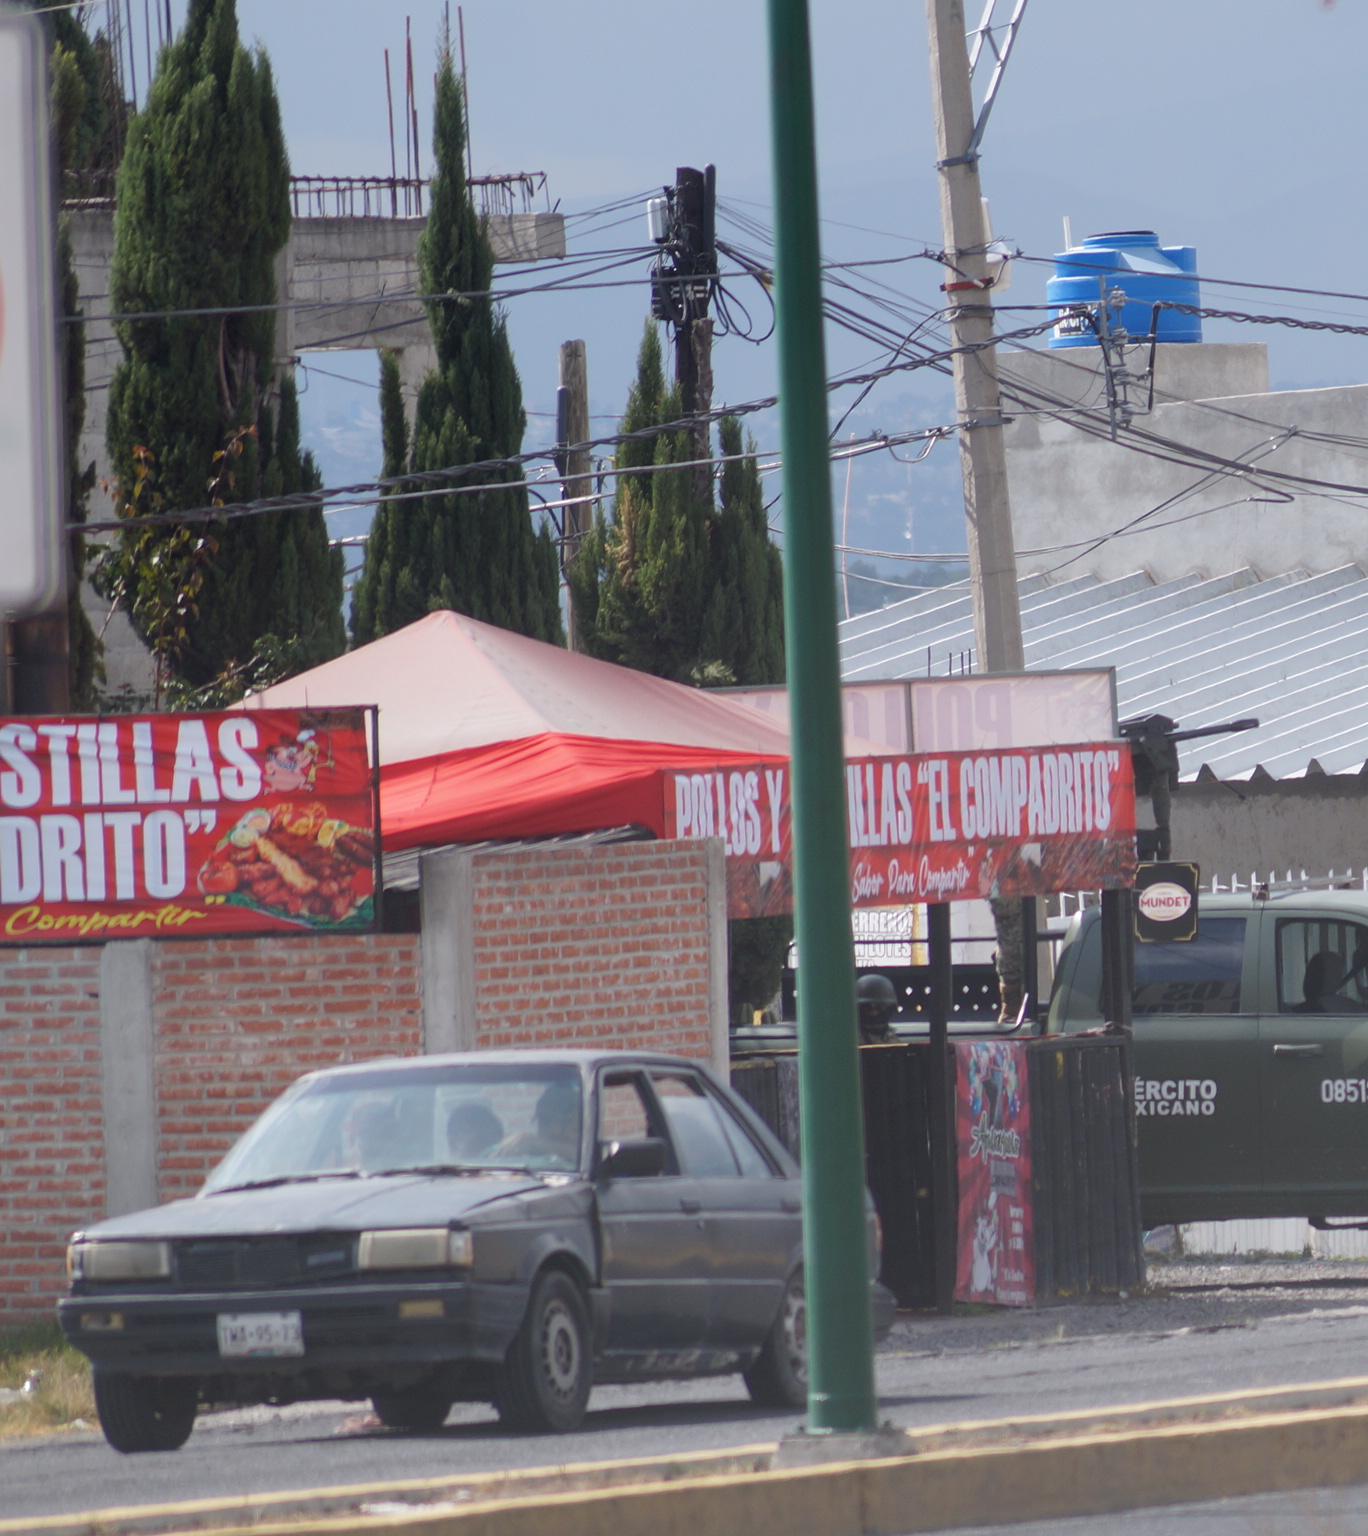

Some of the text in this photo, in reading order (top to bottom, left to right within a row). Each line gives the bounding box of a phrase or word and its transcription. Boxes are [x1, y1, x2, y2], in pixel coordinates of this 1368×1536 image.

[765, 770, 783, 853] Y
[960, 749, 1119, 840] COMPADRITO”
[851, 846, 974, 903] Sabor Para Compartir”
[1140, 896, 1188, 908] MUNDET
